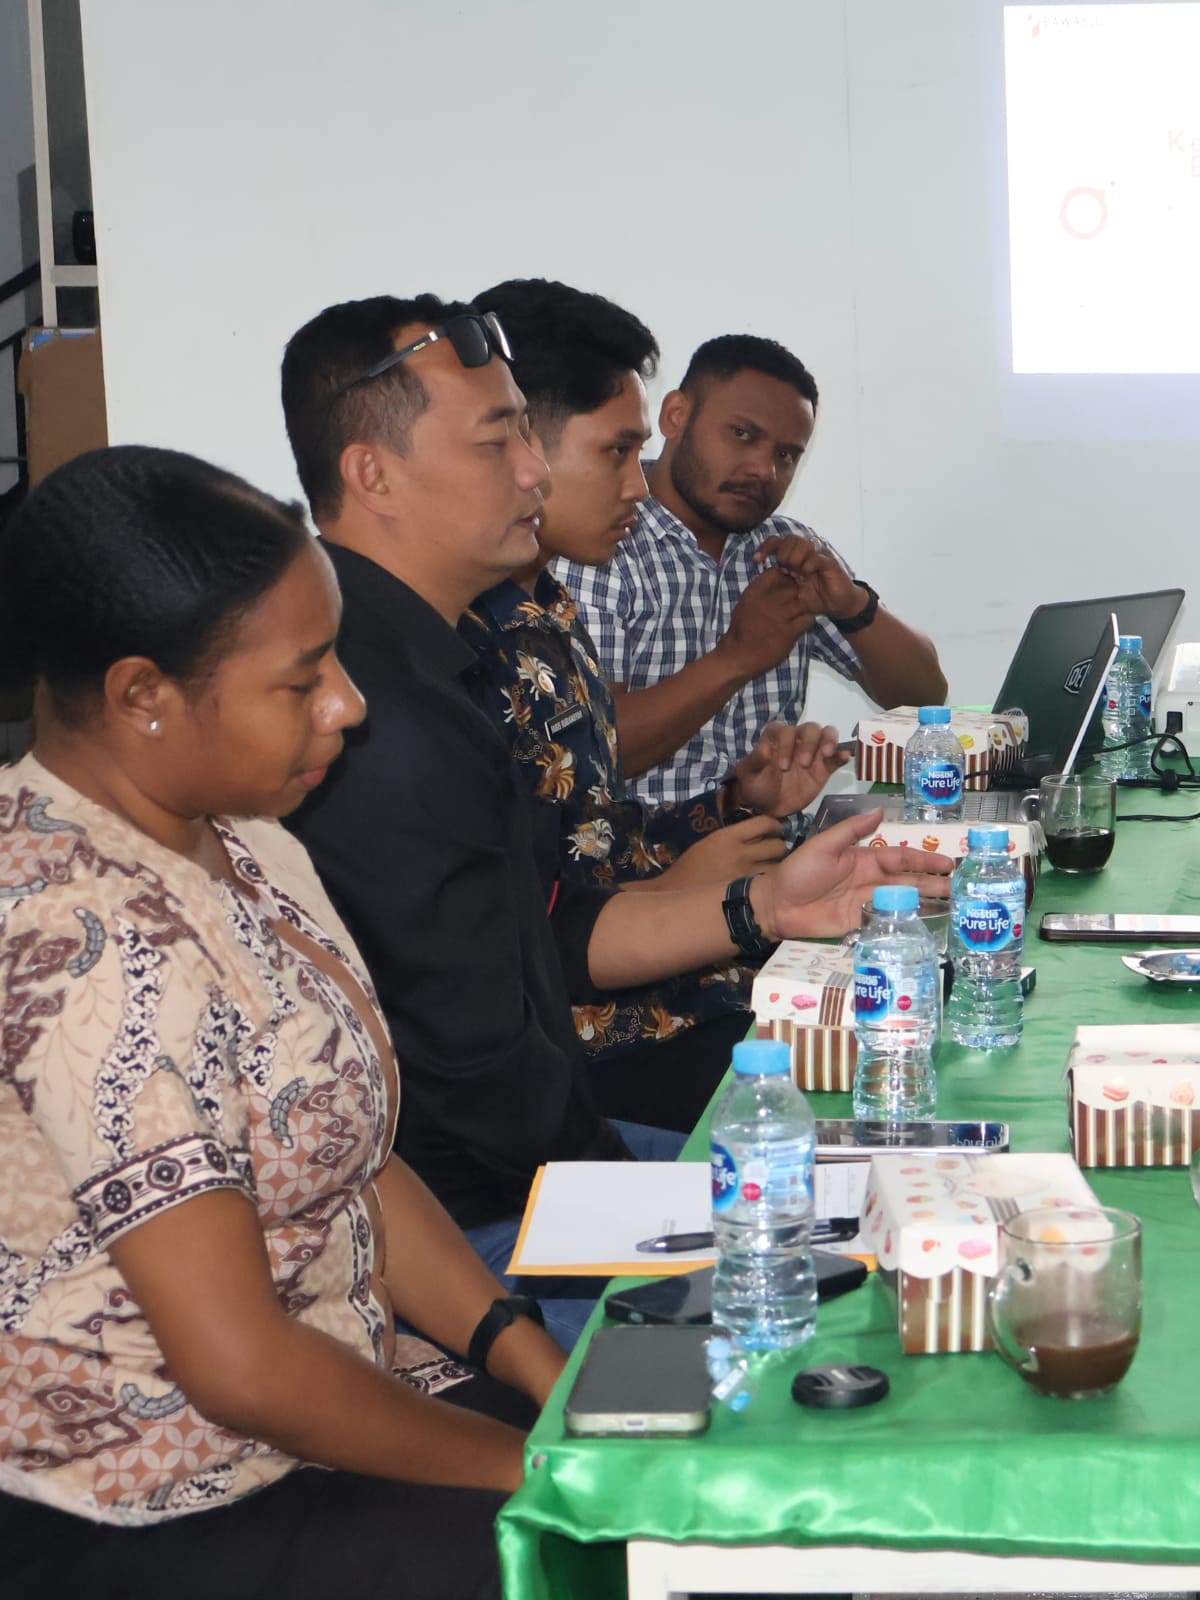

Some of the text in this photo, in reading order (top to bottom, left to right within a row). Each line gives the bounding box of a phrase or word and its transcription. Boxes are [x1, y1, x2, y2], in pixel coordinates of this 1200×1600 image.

[920, 777, 960, 791] Pure Life
[959, 916, 1010, 935] Pure Life
[868, 986, 891, 1005] Life
